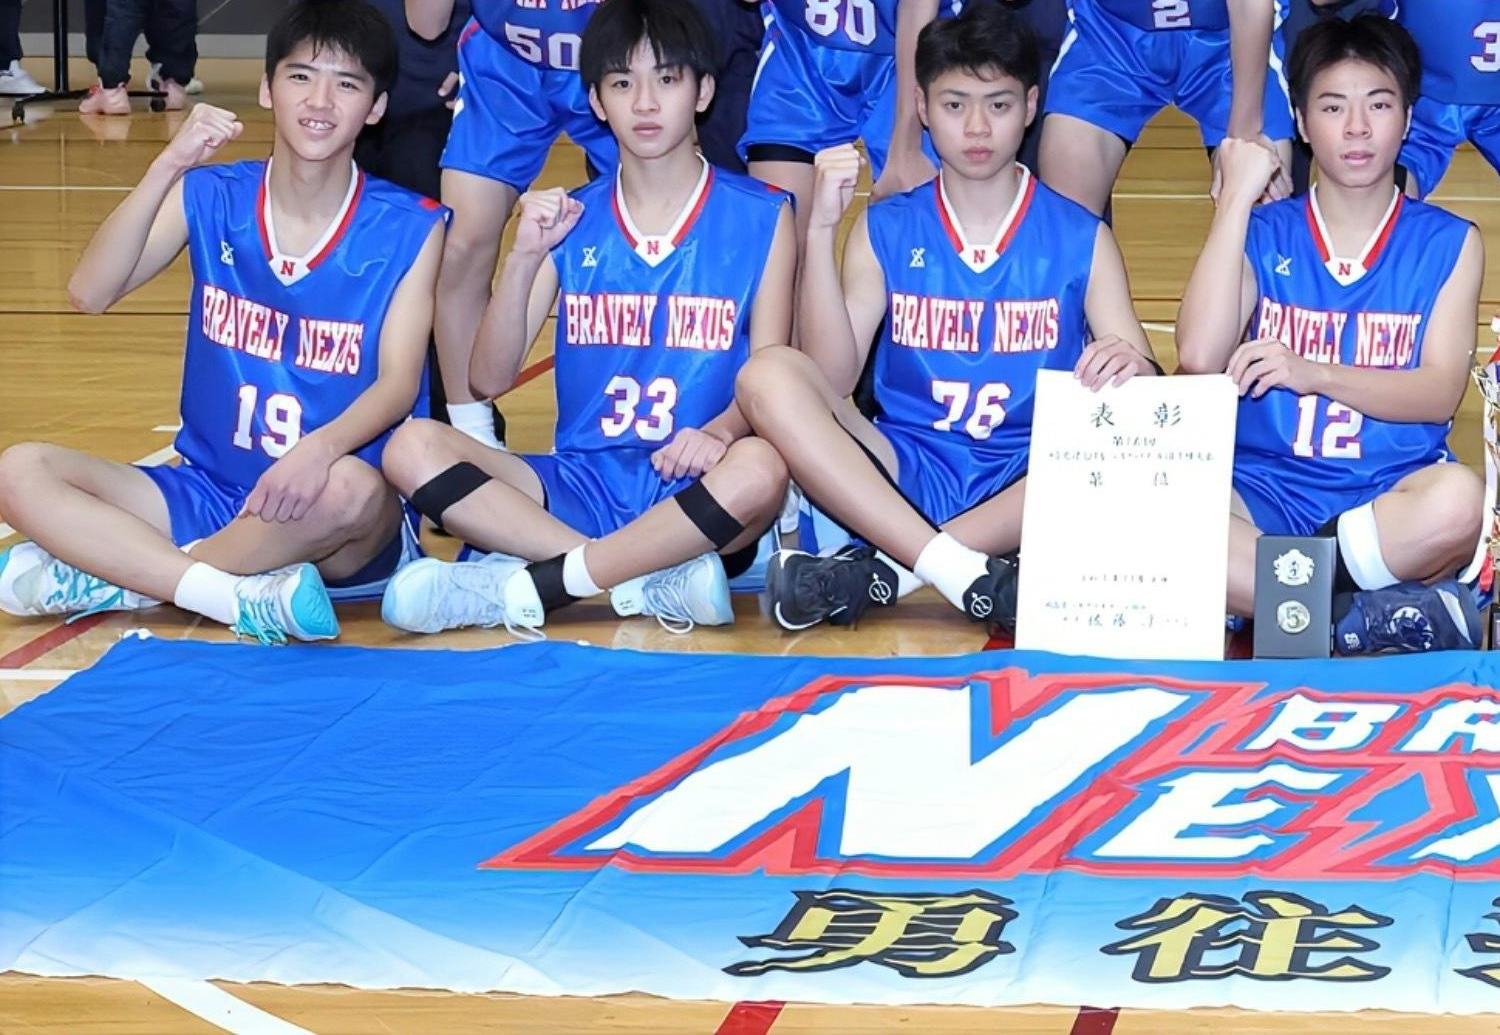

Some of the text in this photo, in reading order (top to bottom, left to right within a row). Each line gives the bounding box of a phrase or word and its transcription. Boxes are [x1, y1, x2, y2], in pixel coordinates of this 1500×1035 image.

[504, 21, 582, 71] 50
[202, 283, 290, 364] BRAVELY
[565, 293, 737, 352] BRAVELY NEXUS
[891, 292, 1060, 353] BRAVELY NEXUS
[1256, 296, 1348, 366] BRAVELY
[232, 384, 303, 459] 19
[600, 375, 678, 441] 33
[931, 379, 1012, 441] 76
[1291, 394, 1365, 459] 12
